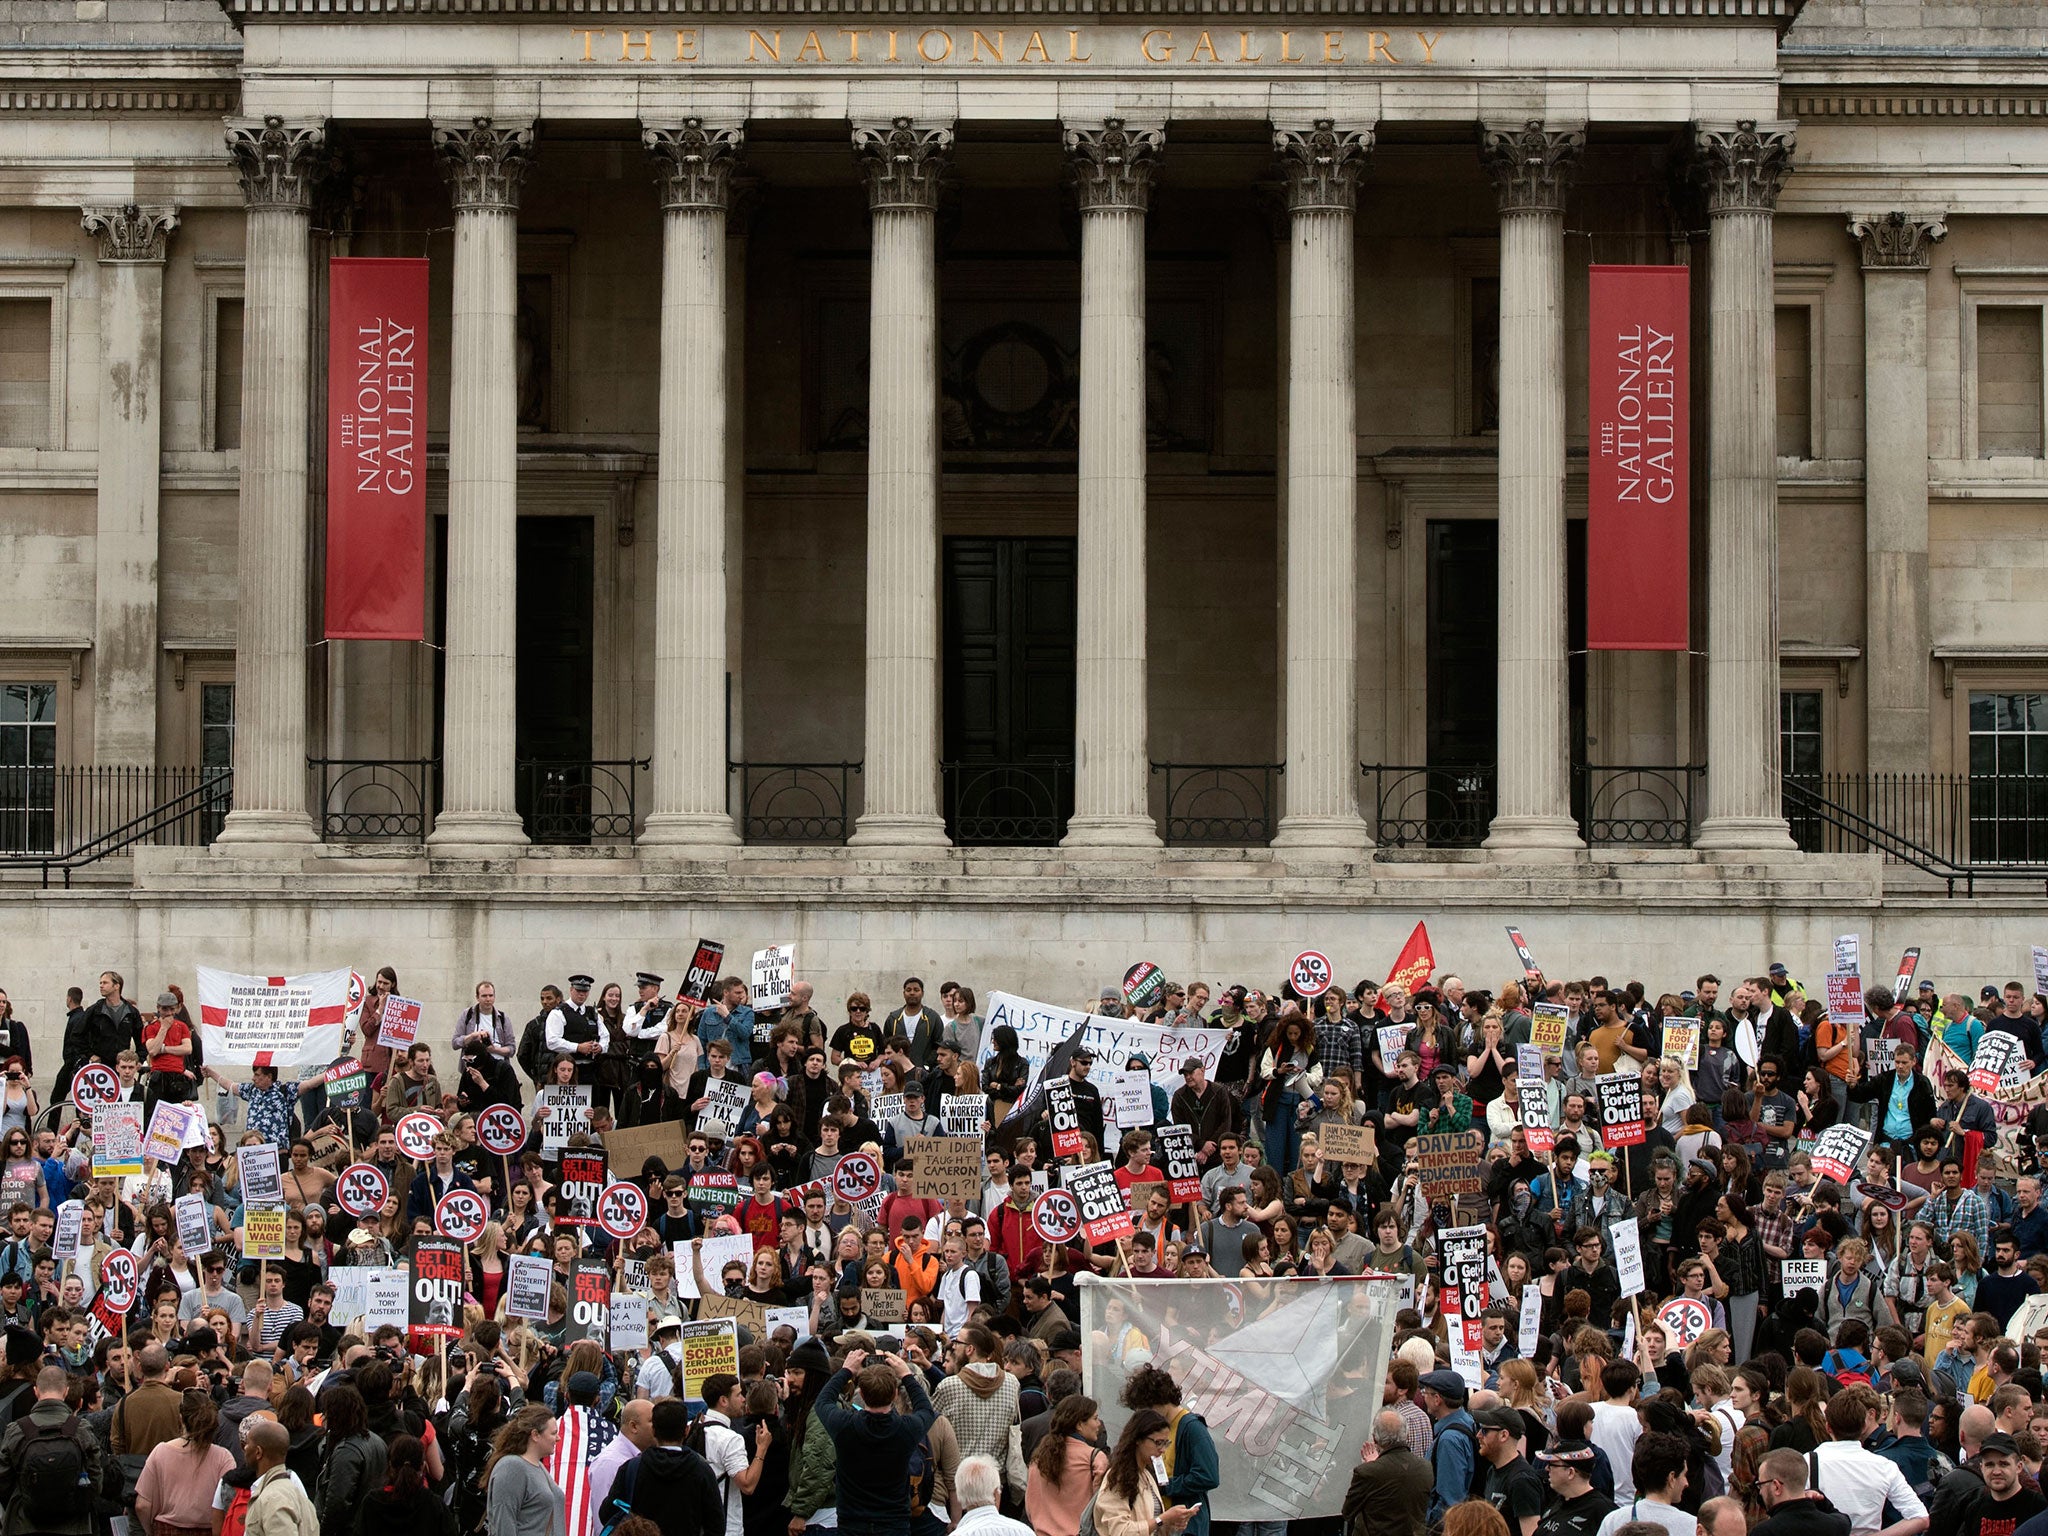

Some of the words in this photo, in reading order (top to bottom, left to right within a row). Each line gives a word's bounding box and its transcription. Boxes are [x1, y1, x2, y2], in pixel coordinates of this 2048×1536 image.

[571, 29, 699, 62] THE
[745, 28, 1093, 63] NATIONAL
[1141, 30, 1447, 63] GALLERY
[357, 317, 382, 494] NATIONAL
[386, 317, 415, 495] GALLERY
[1617, 324, 1642, 503] NATIONAL
[1647, 324, 1674, 504] GALLERY
[341, 413, 353, 448] THE
[1601, 421, 1614, 457] THE
[765, 949, 780, 959] FREE
[755, 956, 790, 970] EDUCATION
[1300, 958, 1321, 970] NO
[688, 966, 716, 988] OUT!
[764, 968, 780, 982] TAX
[1123, 981, 1135, 993] NO
[1132, 962, 1151, 983] MORE
[1294, 972, 1328, 984] CUTS
[231, 987, 256, 996] MAGNA
[256, 988, 279, 996] CARTA
[752, 983, 768, 998] THE
[770, 980, 791, 996] RICH
[1128, 969, 1164, 1004] AUSTERITY
[230, 998, 244, 1006] THIS
[252, 998, 262, 1006] THE
[278, 998, 289, 1006] WAY
[290, 998, 300, 1006] WE
[389, 1002, 408, 1011] TAKE
[228, 1009, 241, 1018] END
[244, 1009, 262, 1018] CHILD
[265, 1009, 286, 1018] SEXUAL
[289, 1009, 308, 1017] ABUSE
[387, 1008, 402, 1018] THE
[227, 1020, 242, 1029] TAKE
[247, 1021, 264, 1029] BACK
[269, 1021, 280, 1029] THE
[384, 1022, 400, 1031] OFF
[400, 1025, 416, 1034] THE
[386, 1015, 418, 1028] WEALTH
[1536, 1022, 1561, 1034] £10
[1534, 1032, 1561, 1043] now
[1670, 1028, 1693, 1036] FAST
[1130, 1037, 1142, 1047] IS
[1160, 1033, 1208, 1054] BAD
[1874, 1040, 1888, 1050] FREE
[1992, 1038, 2010, 1051] the
[325, 1068, 338, 1081] NO
[338, 1059, 360, 1078] MORE
[84, 1073, 108, 1086] NO
[326, 1075, 366, 1095] AUSTERITY
[77, 1087, 114, 1100] CUTS
[558, 1086, 577, 1096] FREE
[718, 1081, 738, 1096] FREE
[1050, 1088, 1070, 1101] Get
[1521, 1090, 1540, 1099] Get
[1600, 1083, 1621, 1095] Get
[1622, 1081, 1639, 1092] the
[548, 1096, 588, 1106] EDUCATION
[944, 1094, 983, 1105] STUDENTS
[1601, 1092, 1640, 1108] Tories
[558, 1108, 577, 1122] TAX
[712, 1106, 733, 1122] TAX
[941, 1108, 948, 1118] &
[949, 1106, 984, 1117] WORKERS
[1118, 1104, 1149, 1113] AUSTERITY
[1604, 1102, 1641, 1124] Out!
[488, 1114, 514, 1126] NO
[948, 1118, 978, 1133] UNITE
[406, 1122, 430, 1134] NO
[483, 1128, 521, 1140] CUTS
[544, 1122, 564, 1136] THE
[1801, 1130, 1812, 1139] NO
[1059, 1136, 1078, 1148] Fight
[1164, 1138, 1184, 1148] Get
[1418, 1133, 1476, 1153] DAVID
[1823, 1130, 1842, 1138] Get
[1844, 1130, 1862, 1147] the
[906, 1140, 941, 1153] WHAT
[950, 1141, 979, 1154] IDIOT
[1820, 1136, 1858, 1155] Tories
[926, 1156, 975, 1165] TAUGHT
[1418, 1150, 1479, 1168] THATCHER
[1813, 1145, 1856, 1167] Out!
[245, 1163, 275, 1172] AUSTERITY
[562, 1160, 584, 1170] GET
[586, 1161, 604, 1171] THE
[843, 1161, 867, 1174] NO
[924, 1166, 978, 1176] CAMERON
[350, 1174, 375, 1186] NO
[562, 1170, 603, 1184] TORIES
[693, 1174, 706, 1186] NO
[708, 1174, 733, 1186] MORE
[1420, 1165, 1480, 1184] EDUCATION
[838, 1175, 874, 1190] CUTS
[1074, 1176, 1097, 1192] Get
[1098, 1171, 1114, 1184] the
[688, 1188, 738, 1202] AUSTERITY
[1076, 1184, 1118, 1204] Tories
[1421, 1180, 1480, 1197] SNATCHER
[342, 1189, 382, 1202] CUTS
[611, 1192, 637, 1206] NO
[447, 1200, 473, 1214] NO
[1046, 1198, 1070, 1212] NO
[1082, 1194, 1124, 1220] Out!
[442, 1213, 482, 1231] CUTS
[604, 1208, 640, 1223] CUTS
[1038, 1212, 1076, 1229] CUTS
[248, 1224, 282, 1232] LIVING
[250, 1232, 280, 1241] WAGE
[1470, 1238, 1484, 1249] the
[1619, 1244, 1636, 1255] SMASH
[416, 1250, 442, 1264] GET
[445, 1252, 462, 1266] THE
[1623, 1254, 1636, 1264] TORY
[110, 1260, 130, 1277] NO
[416, 1264, 462, 1282] TORIES
[1787, 1262, 1818, 1273] FREE
[514, 1276, 546, 1286] AUSTERITY
[575, 1274, 602, 1288] GET
[1784, 1276, 1824, 1285] EDUCATION
[415, 1278, 462, 1306] OUT!
[864, 1292, 880, 1300] WE
[886, 1291, 903, 1300] WILL
[868, 1309, 899, 1317] SILENCED
[1680, 1304, 1703, 1328] NO
[1664, 1311, 1697, 1343] CUTS
[686, 1346, 734, 1360] SCRAP
[686, 1356, 735, 1368] ZERO-HOUR
[686, 1364, 736, 1376] CONTRACTS
[1543, 1520, 1560, 1532] AIG
